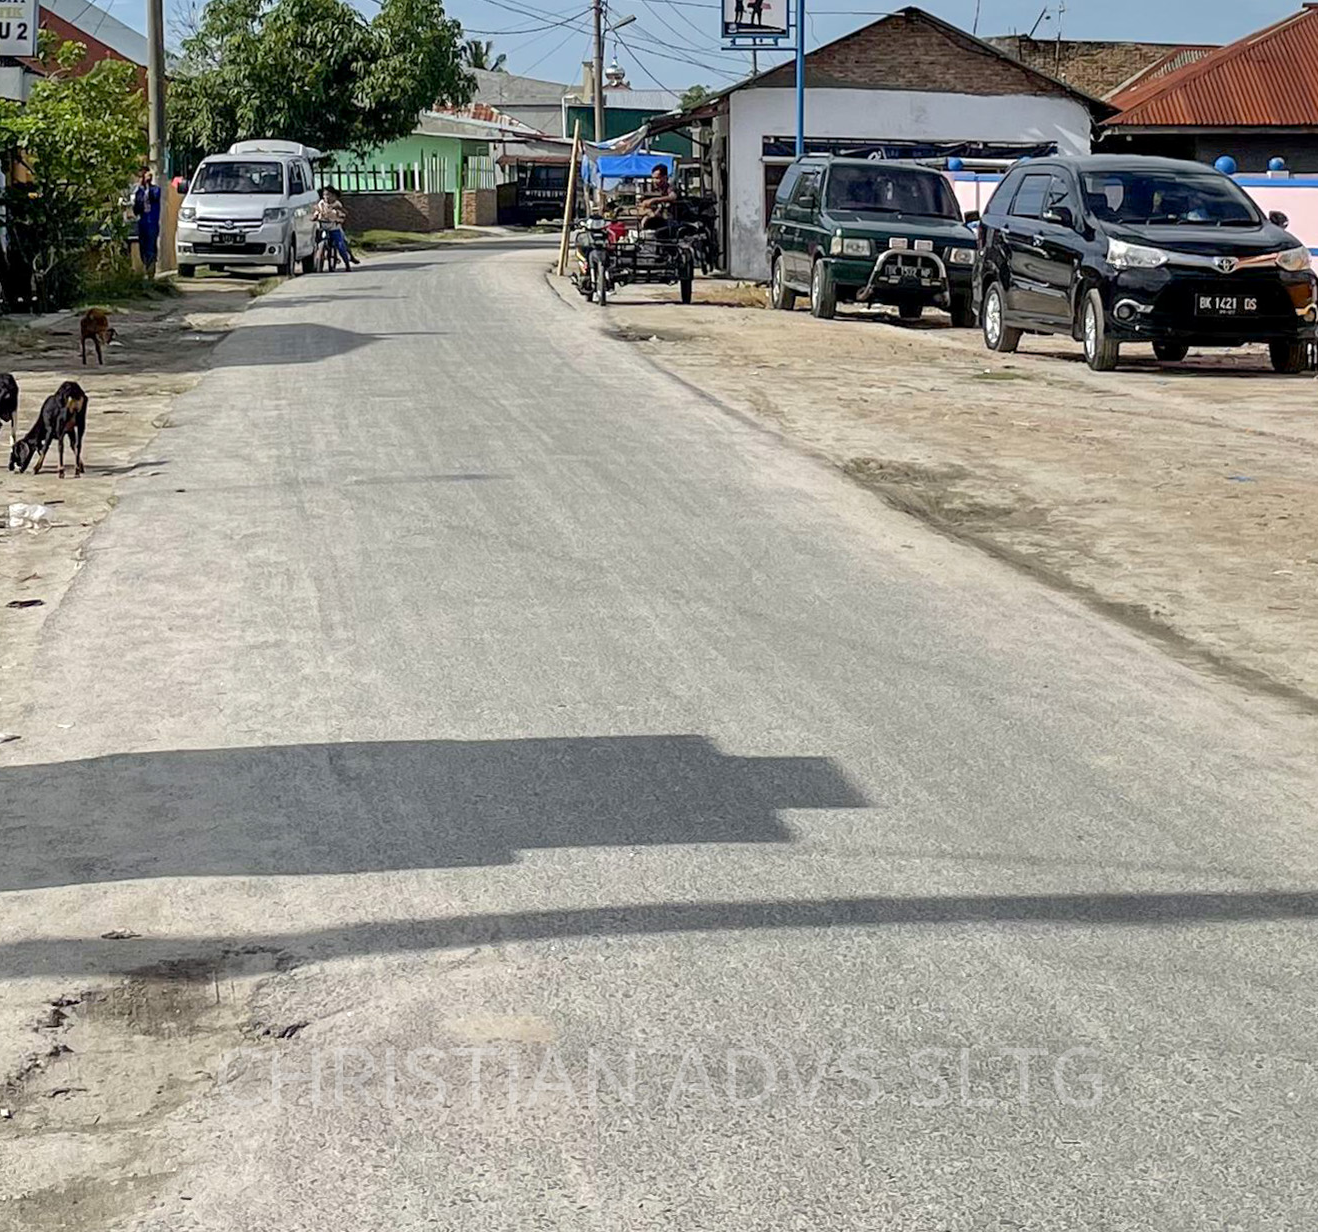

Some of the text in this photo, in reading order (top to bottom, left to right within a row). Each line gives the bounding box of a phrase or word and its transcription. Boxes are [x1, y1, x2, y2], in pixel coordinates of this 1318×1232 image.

[16, 23, 28, 41] 2
[1199, 296, 1212, 309] BK
[1215, 297, 1237, 309] 1421
